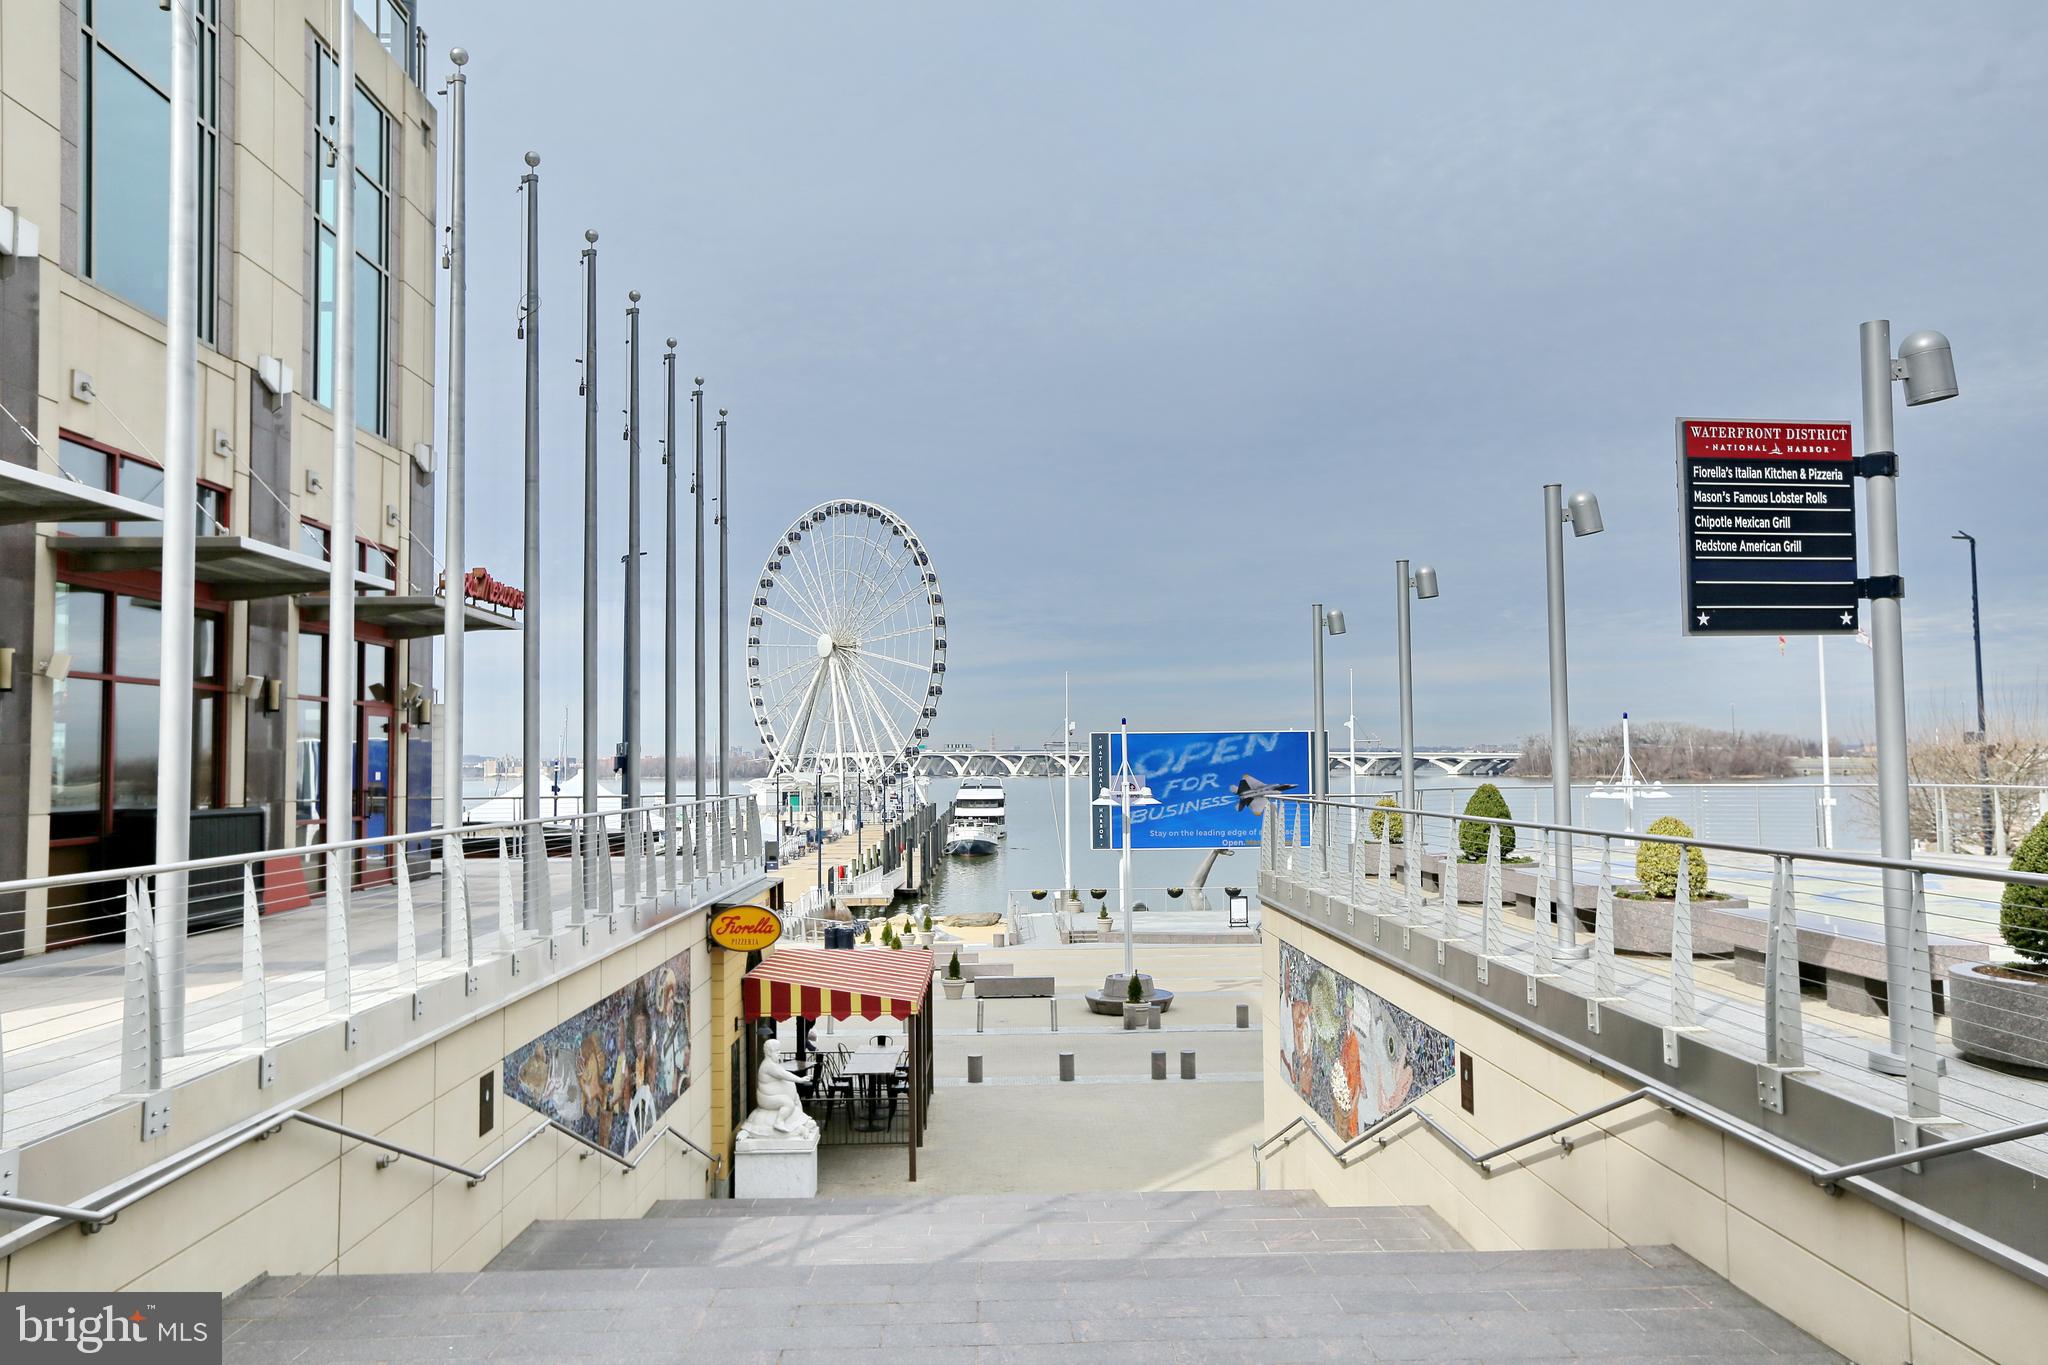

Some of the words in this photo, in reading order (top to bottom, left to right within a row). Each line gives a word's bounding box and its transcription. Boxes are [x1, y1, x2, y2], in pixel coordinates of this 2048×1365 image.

[1690, 426, 1782, 440] WATERFRONT
[1785, 428, 1848, 441] DISTRICT
[1712, 443, 1767, 452] NATIONAL
[1787, 445, 1829, 453] HARBOR
[1693, 465, 1733, 479] Fiorella's
[1735, 466, 1763, 479] Italian
[1764, 467, 1798, 480] Kitchen
[1799, 467, 1807, 480] &
[1808, 468, 1843, 481] Pizzeria
[1693, 490, 1731, 503] Mason's
[1733, 491, 1769, 504] Famous
[1769, 491, 1804, 504] Lobster
[1805, 491, 1828, 504] Rolls
[1694, 514, 1733, 530] Chipotle
[1734, 515, 1771, 529] Mexican
[1772, 516, 1791, 529] Grill
[1695, 539, 1738, 552] Redstone
[1739, 539, 1782, 553] American
[1783, 540, 1802, 553] Grill
[1134, 733, 1280, 779] OPEN
[1162, 773, 1221, 799] FOR
[1130, 795, 1236, 825] BUSINESS
[1149, 829, 1167, 838] Stay
[1180, 829, 1194, 837] the
[1195, 829, 1226, 838] leading
[1227, 829, 1247, 838] edge
[1248, 829, 1258, 837] of
[716, 915, 775, 935] Fiorella
